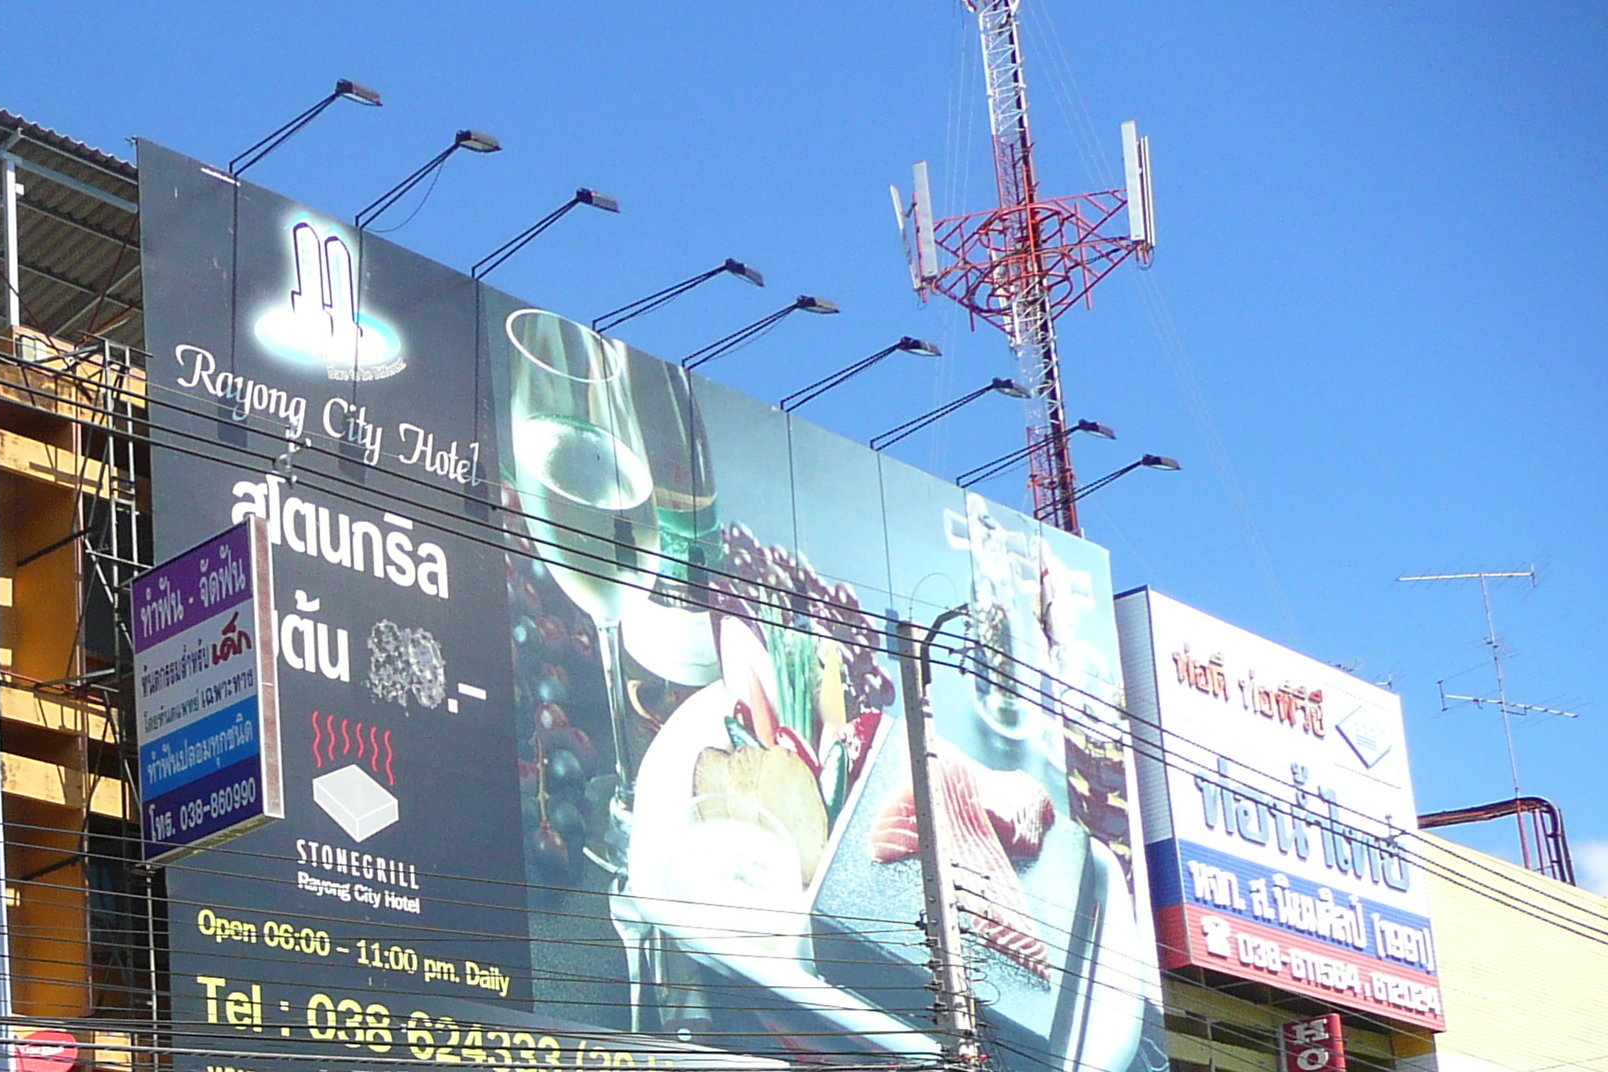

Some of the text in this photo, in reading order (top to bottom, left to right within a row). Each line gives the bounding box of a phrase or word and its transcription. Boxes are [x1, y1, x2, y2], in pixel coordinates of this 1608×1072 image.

[175, 343, 480, 487] Rayong City Hotel
[141, 576, 184, 638] ทำฟัน
[199, 544, 246, 609] จัดฟัน
[211, 611, 252, 666] เด็ก
[179, 776, 256, 832] 038-860990
[296, 839, 420, 890] STONEGRILL
[298, 871, 421, 915] Rayong City Hotel
[198, 909, 256, 943] Open
[264, 921, 330, 957] 06:00
[356, 939, 418, 974] 11:00
[424, 958, 461, 983] pm.
[465, 961, 510, 997] Daily
[197, 976, 264, 1033] Tel
[307, 993, 392, 1053] 038
